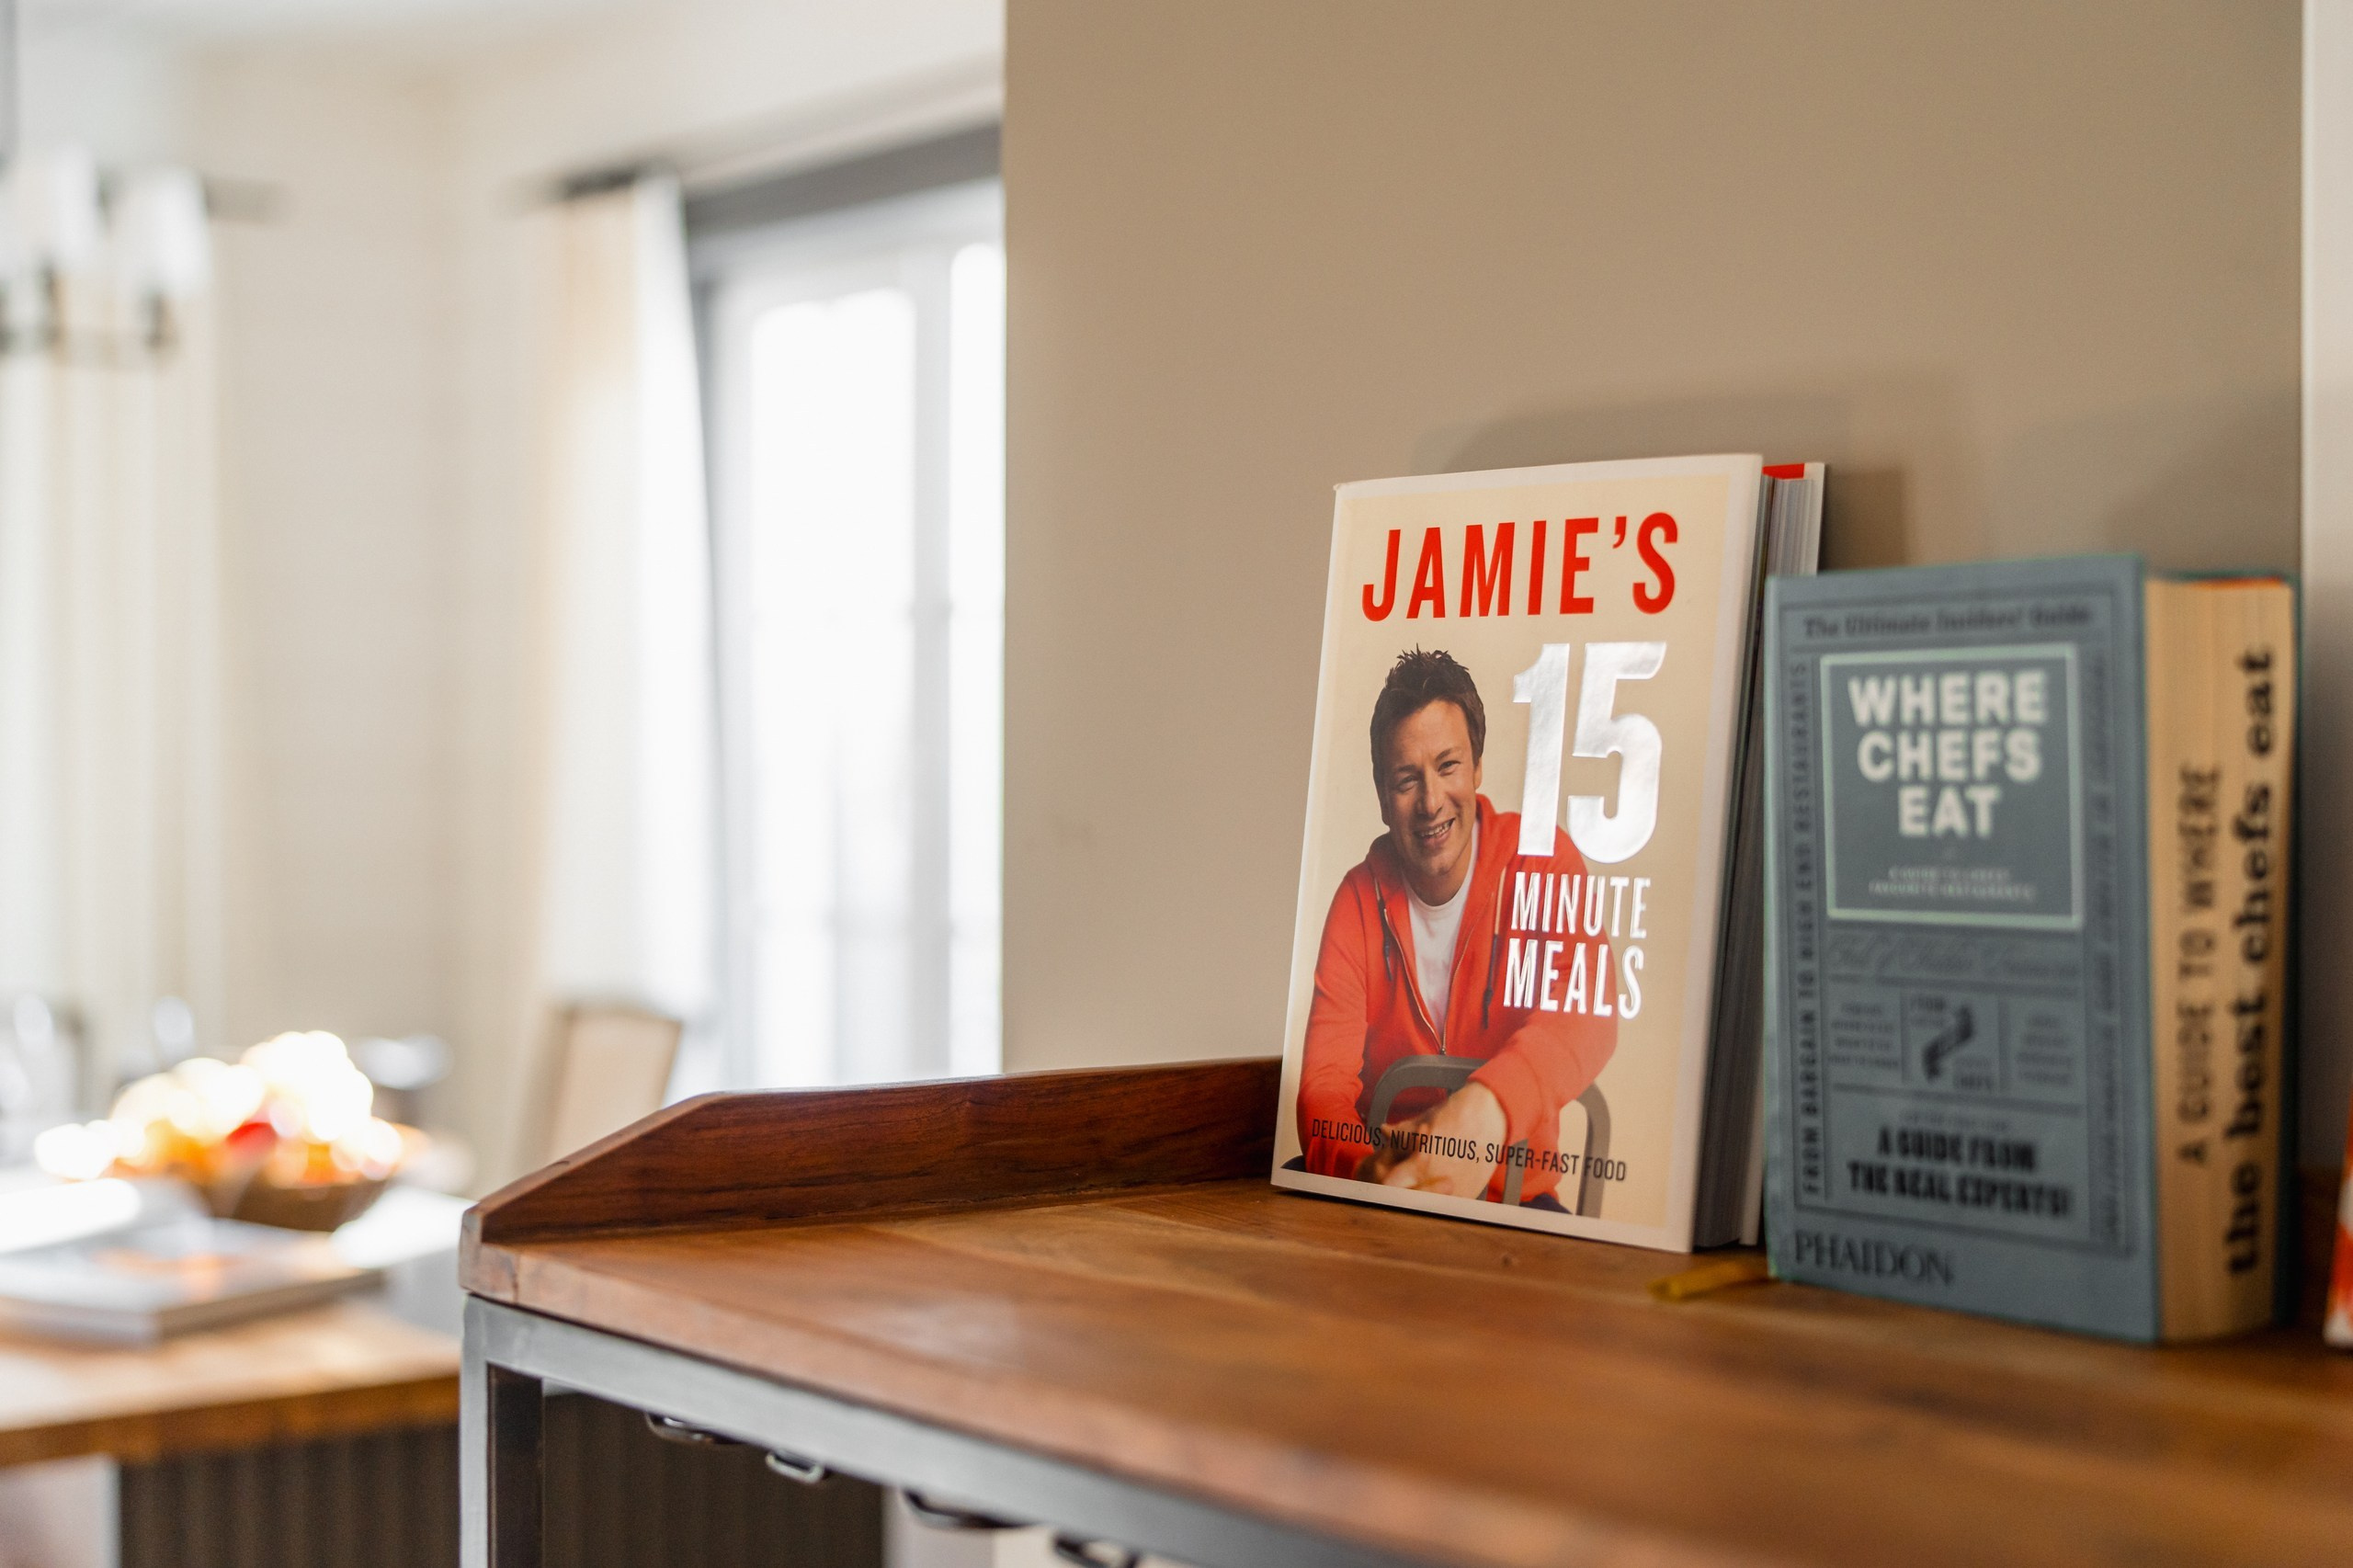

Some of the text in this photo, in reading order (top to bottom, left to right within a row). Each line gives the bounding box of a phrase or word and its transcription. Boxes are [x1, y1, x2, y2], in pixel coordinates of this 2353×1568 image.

[1362, 511, 1678, 621] JAMIE’S
[1848, 669, 2048, 727] WHERE
[1513, 642, 1666, 863] 15
[1857, 729, 2042, 784] CHEFS
[1898, 785, 2002, 838] EAT
[1510, 870, 1651, 938] MINUTE
[1503, 937, 1645, 1020] MEALS
[2177, 928, 2216, 980] TO
[2222, 642, 2278, 1277] the best chefs eat
[1311, 1118, 1627, 1182] DELICIOUS, NUTRITIOUS, SUPER-FAST FOOD
[2176, 1138, 2209, 1169] A
[1794, 1230, 1954, 1286] PHAIDON
